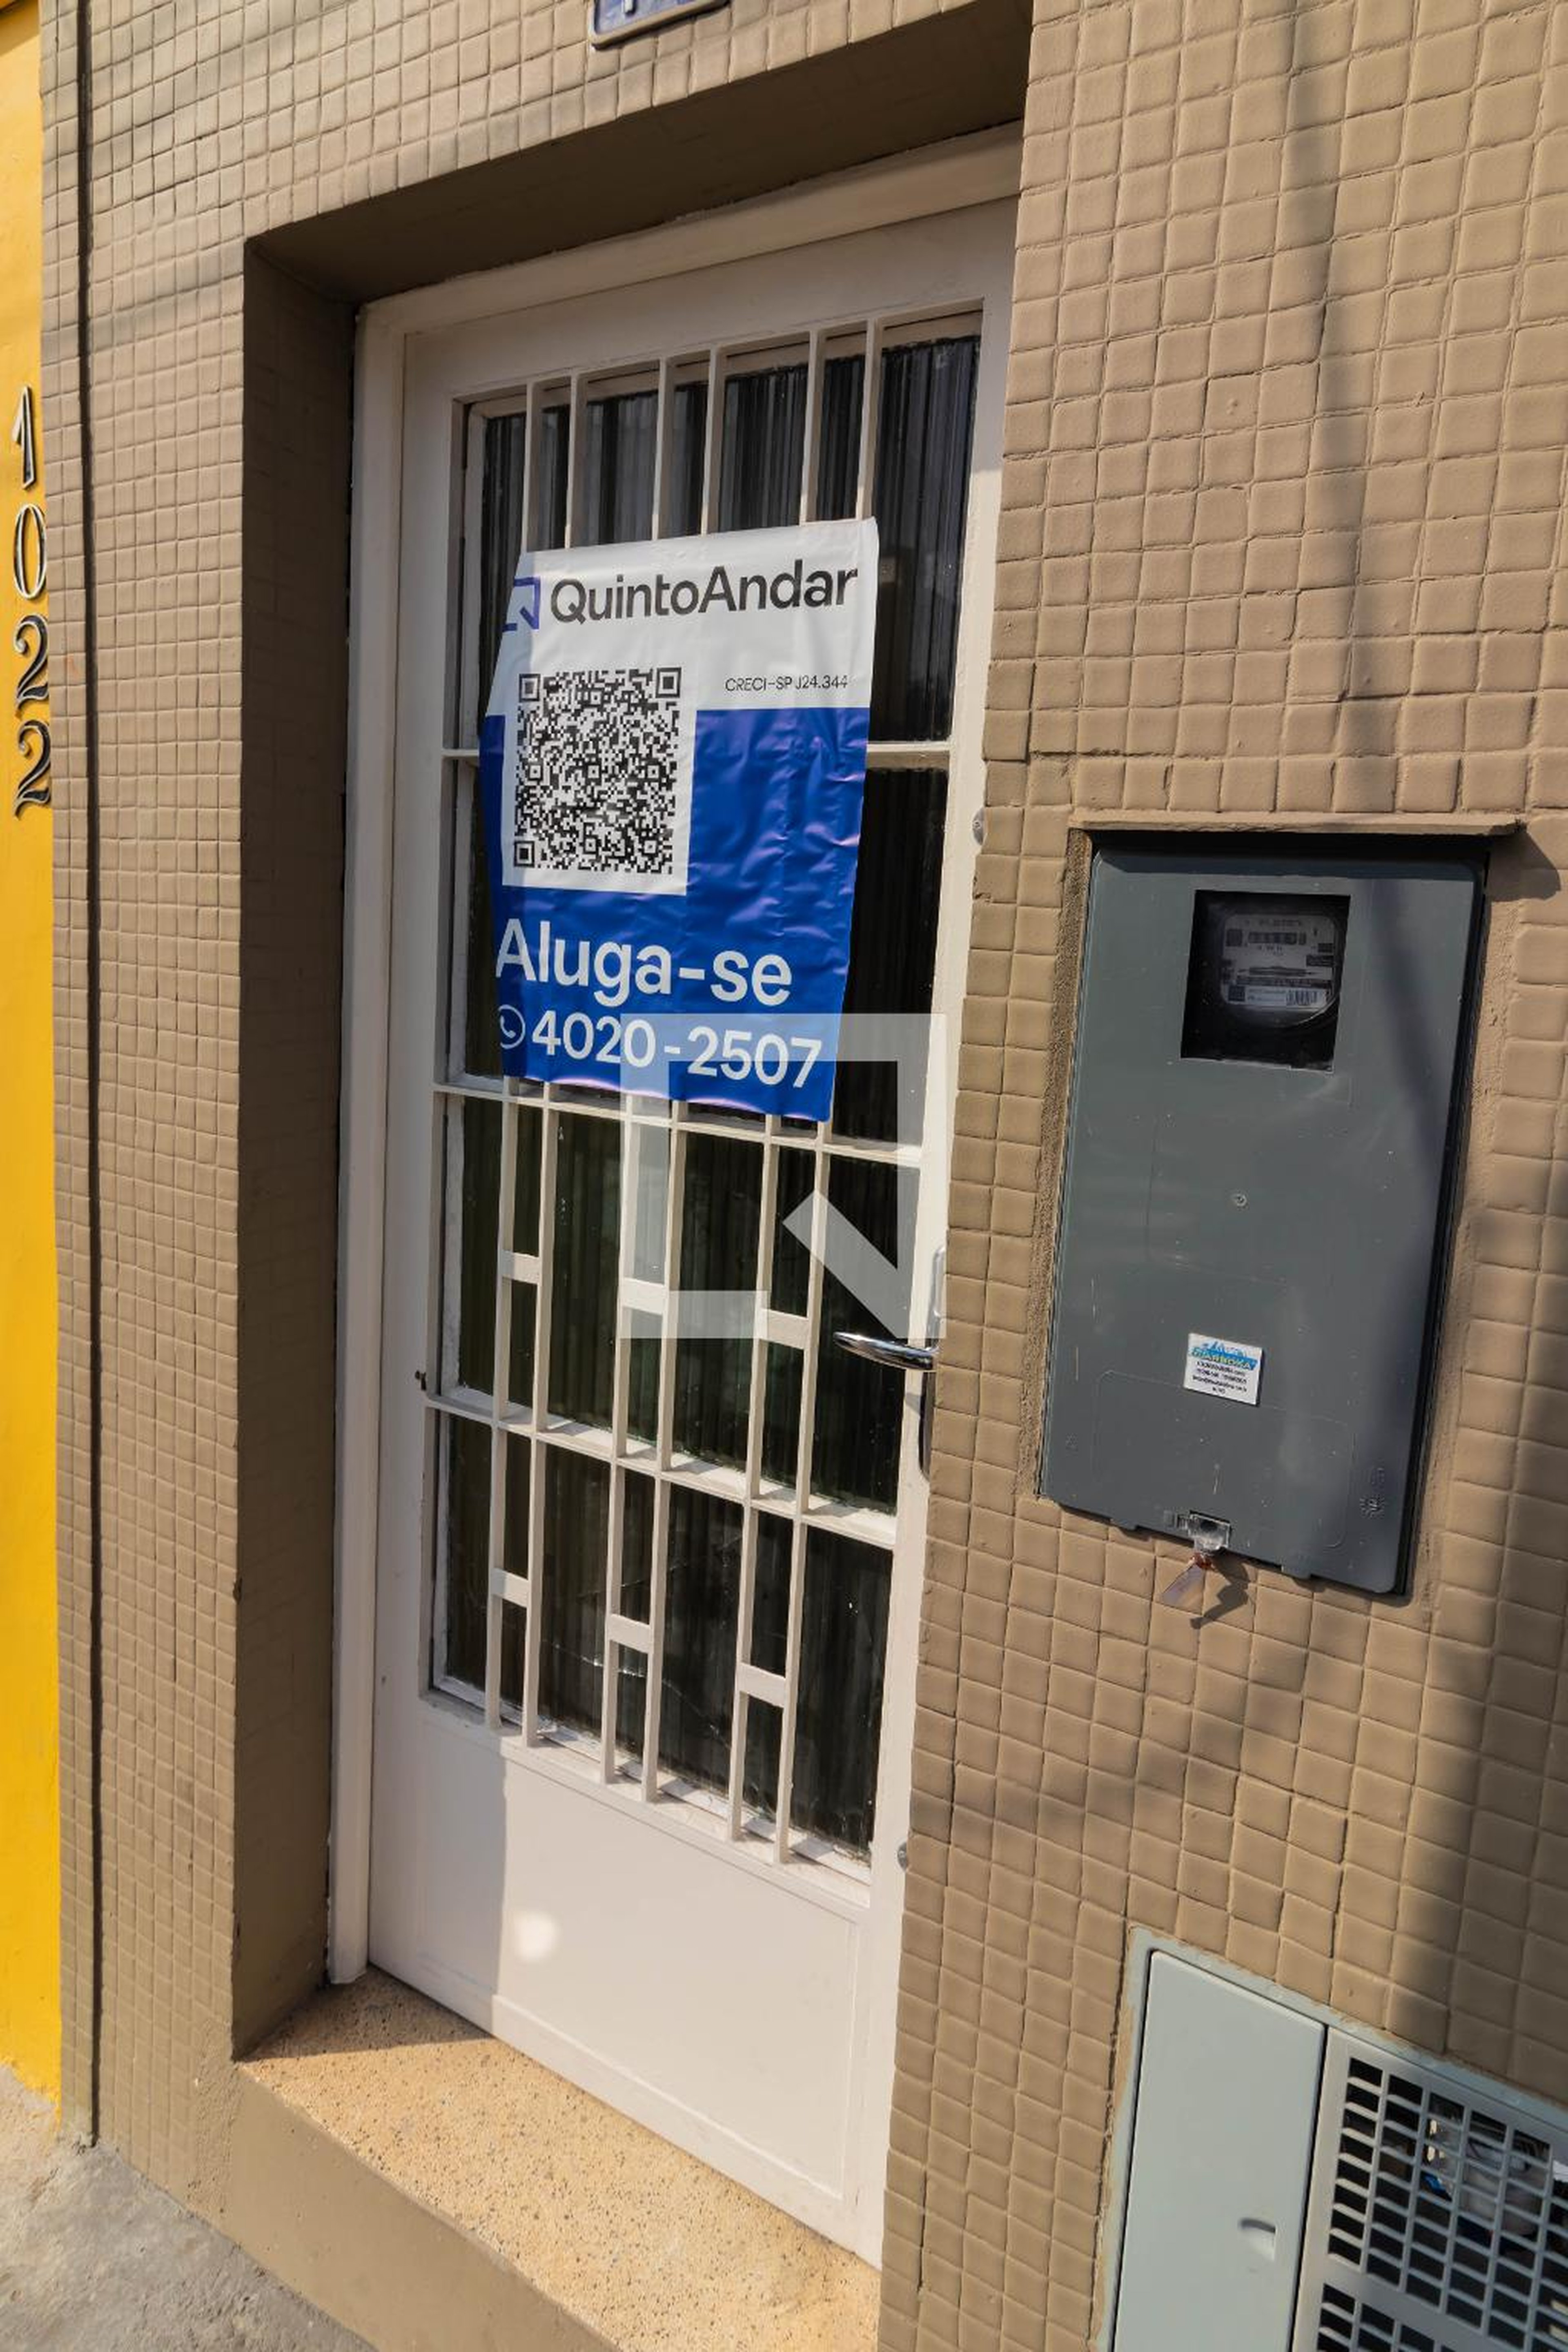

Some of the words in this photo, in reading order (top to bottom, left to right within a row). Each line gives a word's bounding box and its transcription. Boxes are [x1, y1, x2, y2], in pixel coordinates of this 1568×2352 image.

[13, 386, 51, 820] 1022
[551, 559, 858, 624] QuintoAndar
[725, 677, 793, 691] CRECI-SP
[495, 918, 792, 1007] Aluga-se
[532, 1010, 822, 1088] 4020-2507
